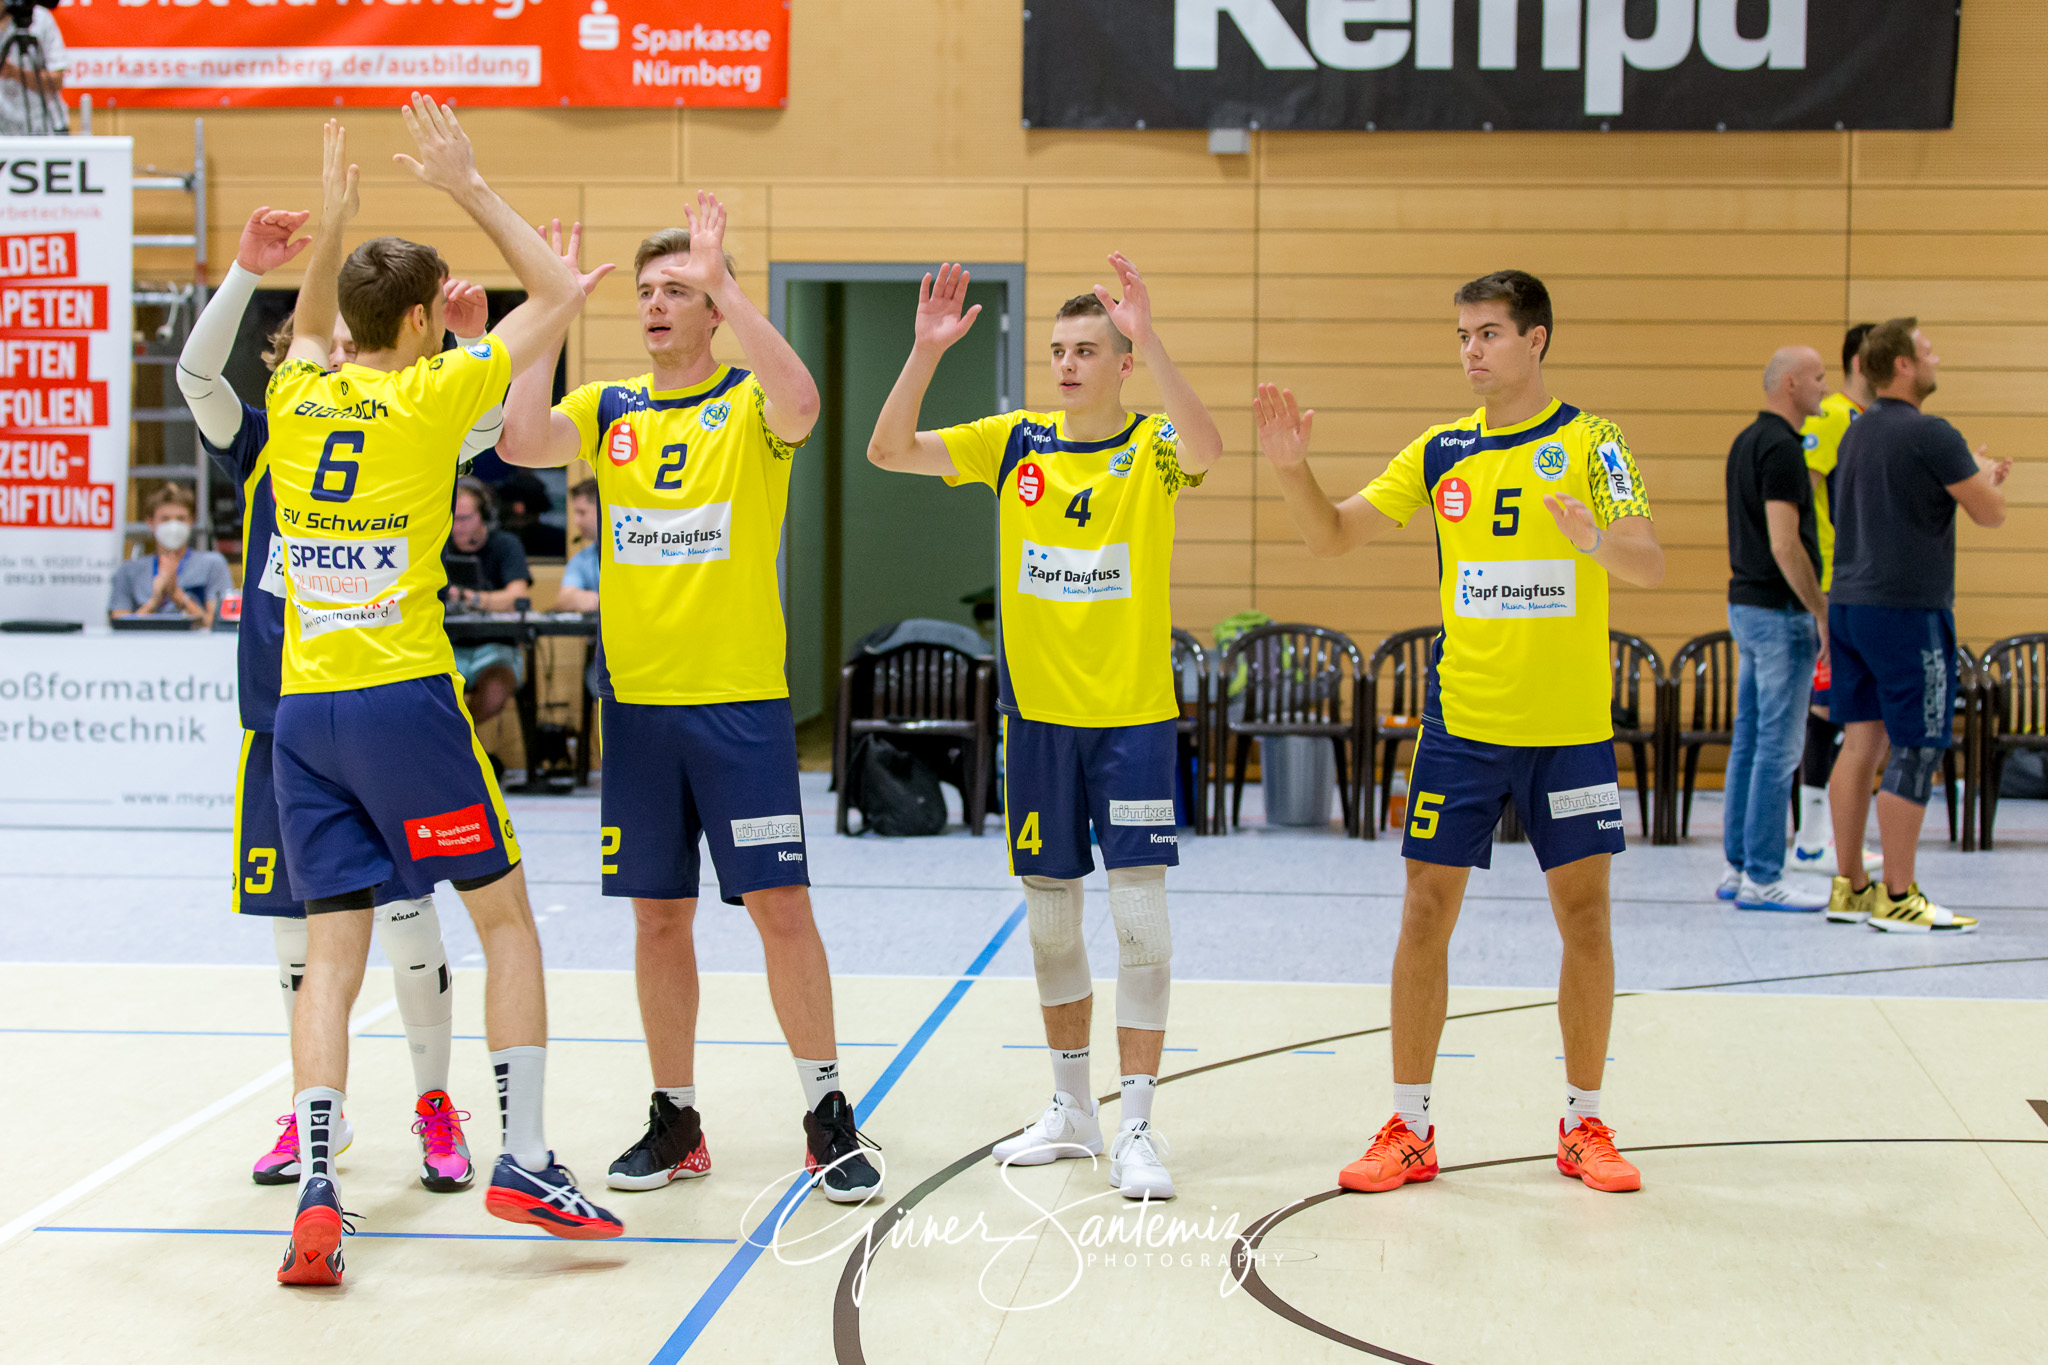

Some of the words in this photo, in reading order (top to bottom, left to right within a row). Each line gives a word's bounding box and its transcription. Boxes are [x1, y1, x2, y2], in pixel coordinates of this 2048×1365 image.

[632, 23, 770, 56] Sparkasse
[632, 59, 761, 92] Nürnberg
[0, 160, 104, 194] SEL
[1440, 436, 1476, 449] Kempa
[310, 430, 365, 502] 6
[654, 443, 688, 489] 2
[1064, 487, 1093, 527] 4
[1492, 488, 1522, 536] 5
[627, 531, 658, 547] Zapf
[661, 527, 722, 546] Daigfuss
[290, 545, 366, 569] SPECK
[1030, 565, 1062, 583] Zapf
[1064, 568, 1120, 585] Daigfuss
[1468, 584, 1498, 600] Zapf
[1501, 584, 1565, 600] Daigfuss
[435, 822, 481, 838] Sparkasse
[1410, 791, 1446, 839] 5
[601, 826, 621, 875] 2
[1016, 812, 1043, 855] 4
[244, 847, 277, 894] 3
